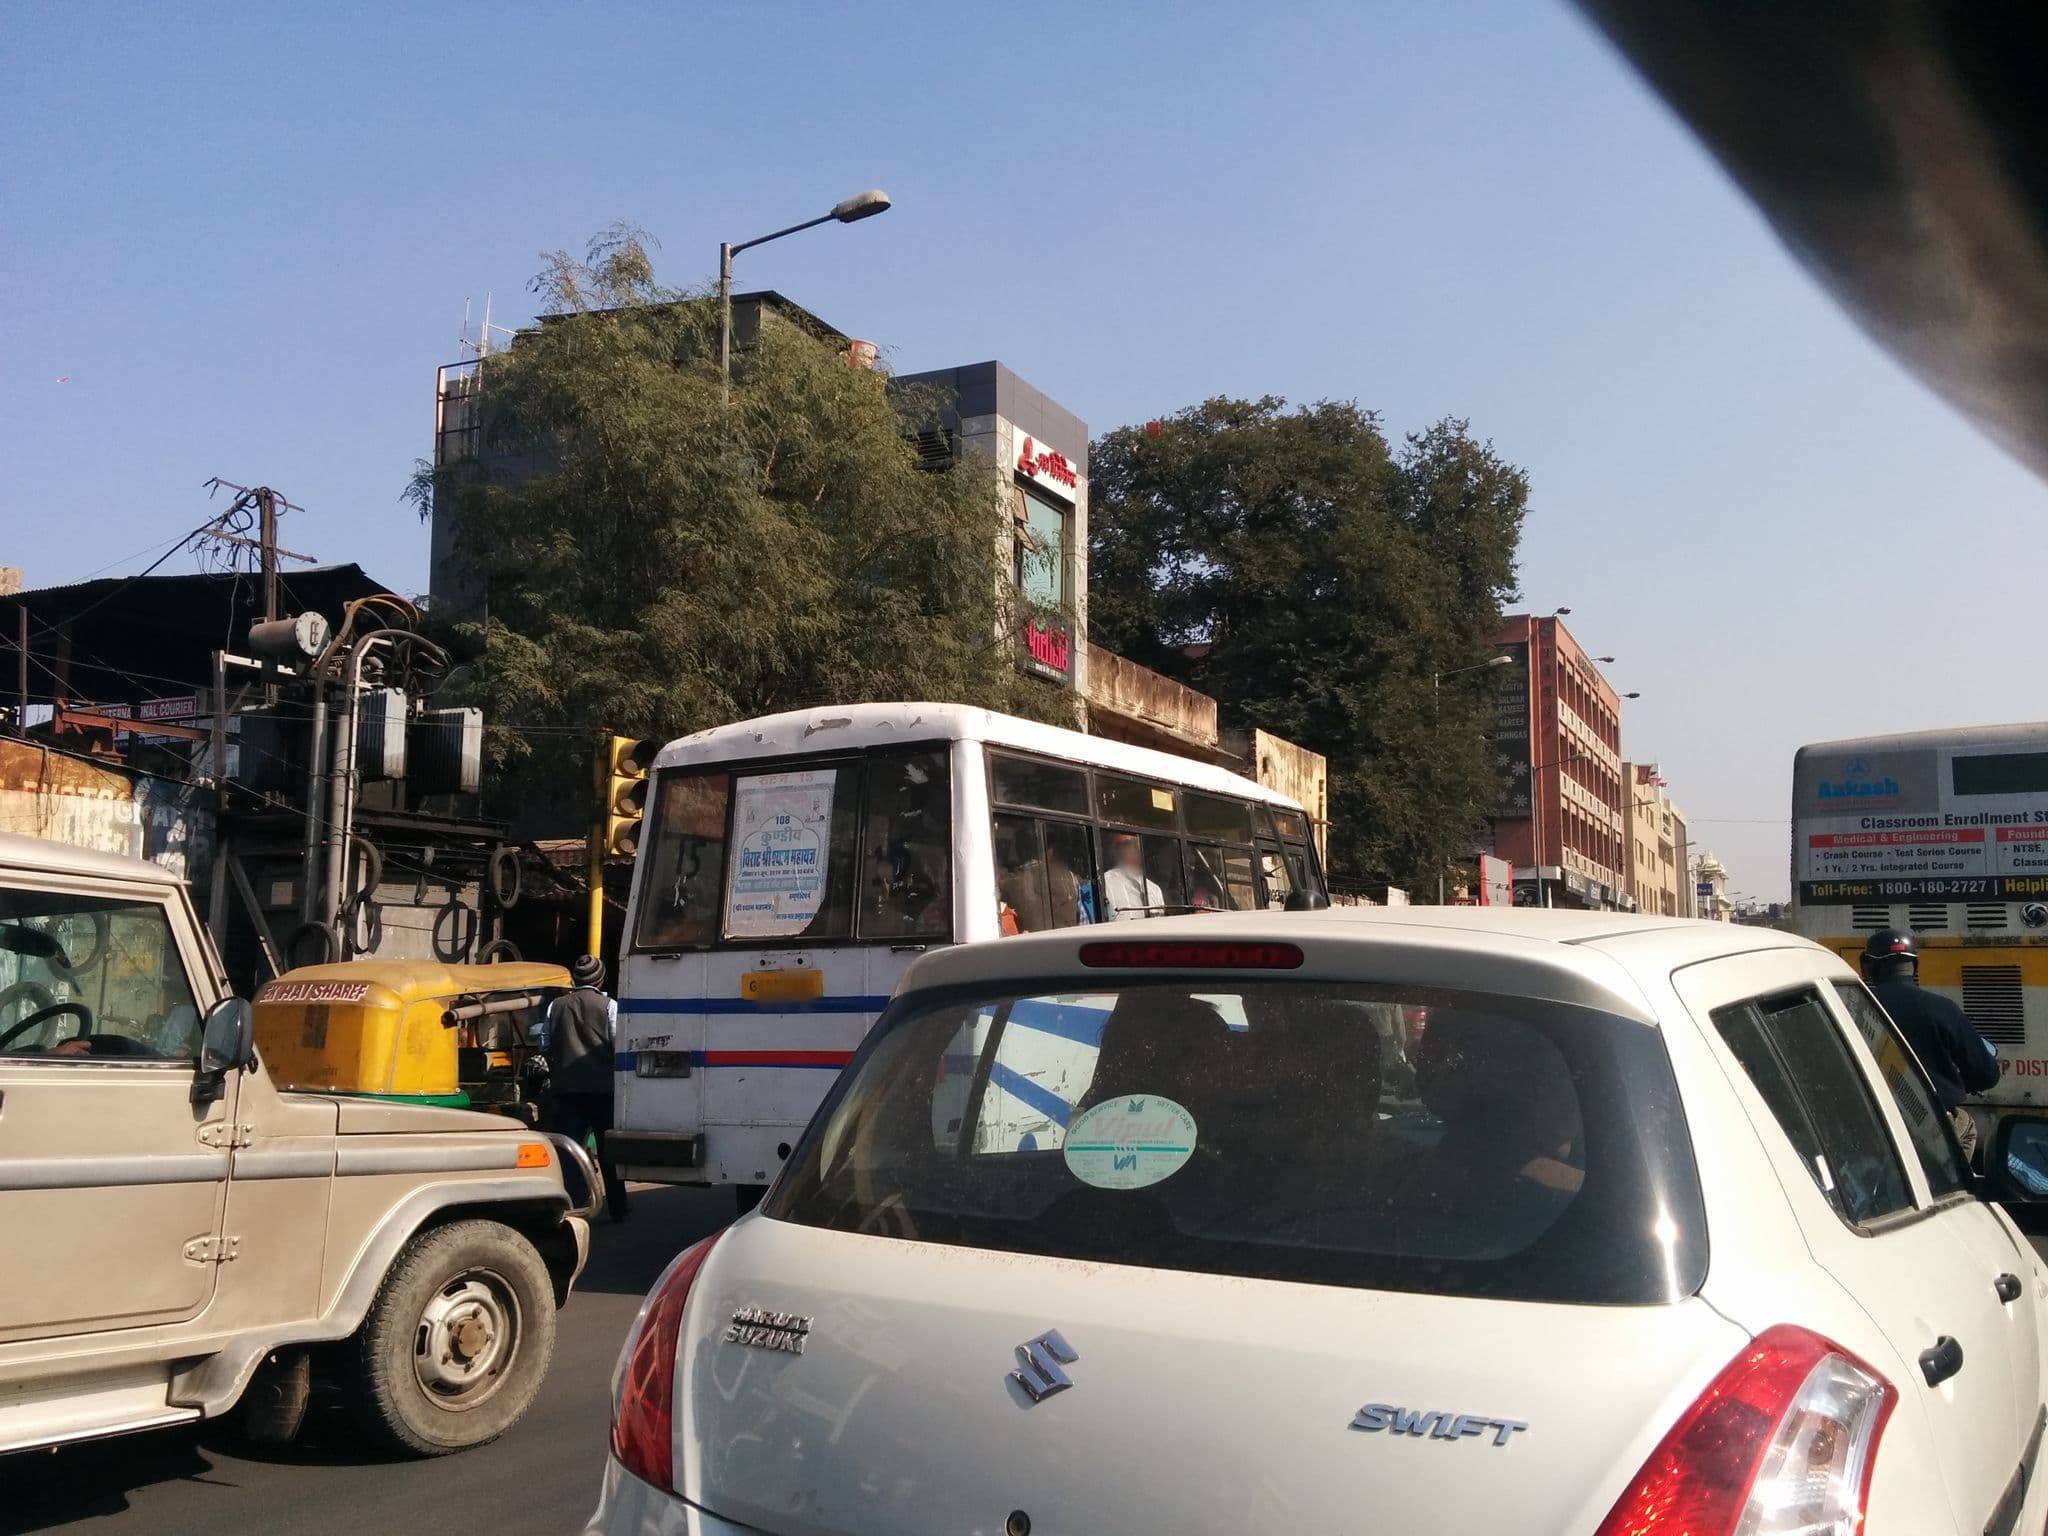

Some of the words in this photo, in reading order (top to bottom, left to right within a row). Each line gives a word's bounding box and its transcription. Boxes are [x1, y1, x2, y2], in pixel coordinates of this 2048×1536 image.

[159, 701, 194, 716] COURIER
[775, 815, 791, 825] 108
[1861, 816, 1939, 830] Classroom
[1944, 811, 2029, 826] Enrollment
[1833, 833, 1877, 845] Medical
[1880, 832, 1888, 843] &
[1892, 830, 1959, 843] Engineering
[1823, 850, 1850, 860] Crash
[1851, 849, 1883, 859] Course
[1895, 848, 1913, 857] Test
[1915, 847, 1945, 857] Series
[1948, 846, 1982, 856] Course
[2013, 844, 2045, 855] NTSE,
[1851, 863, 1858, 872] 2
[1859, 862, 1878, 871] Yrs.
[1881, 861, 1928, 873] Integrated
[1931, 861, 1965, 870] Course
[1811, 883, 1873, 896] Toll-Free:
[1878, 880, 1987, 895] 1800-180-2727
[311, 984, 370, 1001] SHAREF
[1071, 1114, 1090, 1135] GOOD
[1089, 1101, 1119, 1116] SERVICE
[1179, 1113, 1193, 1131] CARE
[731, 1306, 815, 1332] MARUTI
[724, 1324, 810, 1354] SUZUKI
[1350, 1403, 1529, 1446] SWIFT
